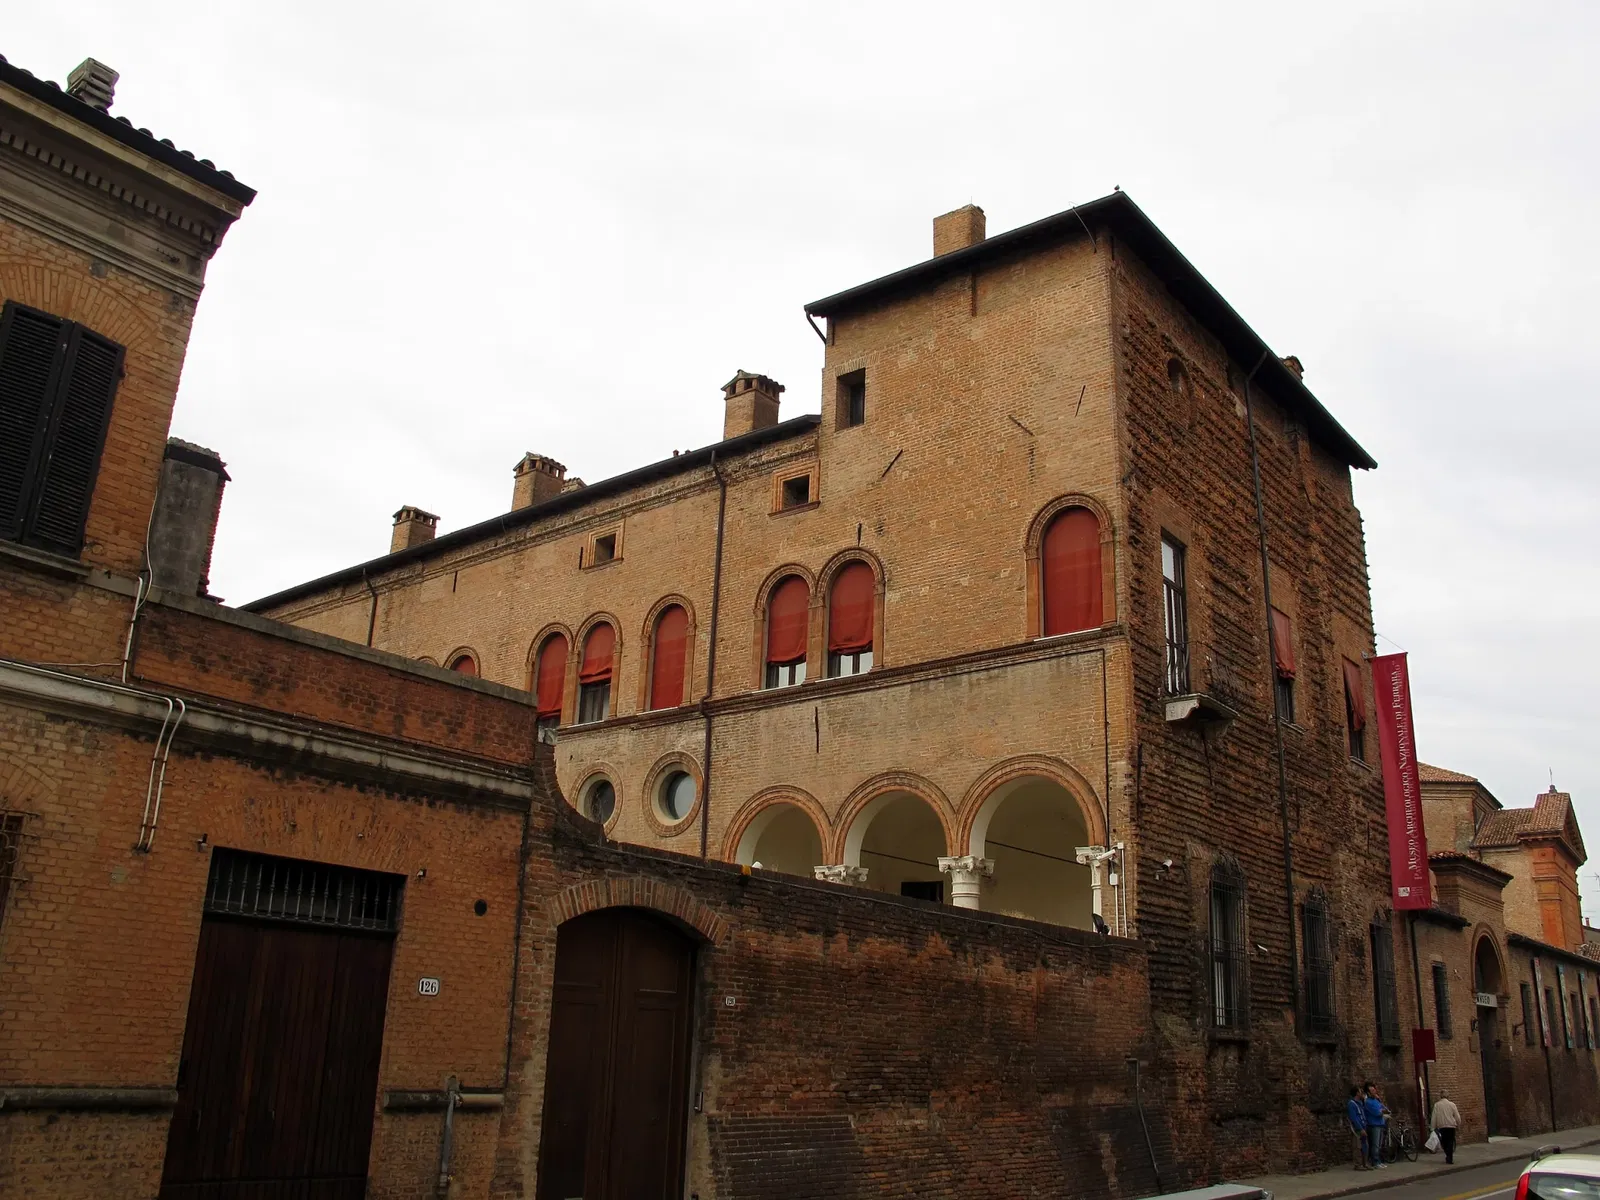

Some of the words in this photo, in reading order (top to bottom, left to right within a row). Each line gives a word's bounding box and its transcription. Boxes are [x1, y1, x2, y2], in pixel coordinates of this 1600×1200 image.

[1391, 671, 1401, 708] FERRARA
[1395, 711, 1403, 720] DI
[1396, 723, 1408, 769] NAZIONALE
[1401, 772, 1414, 835] ARCHEOLOGICO
[1407, 839, 1418, 870] MUSEO
[420, 980, 437, 994] 126
